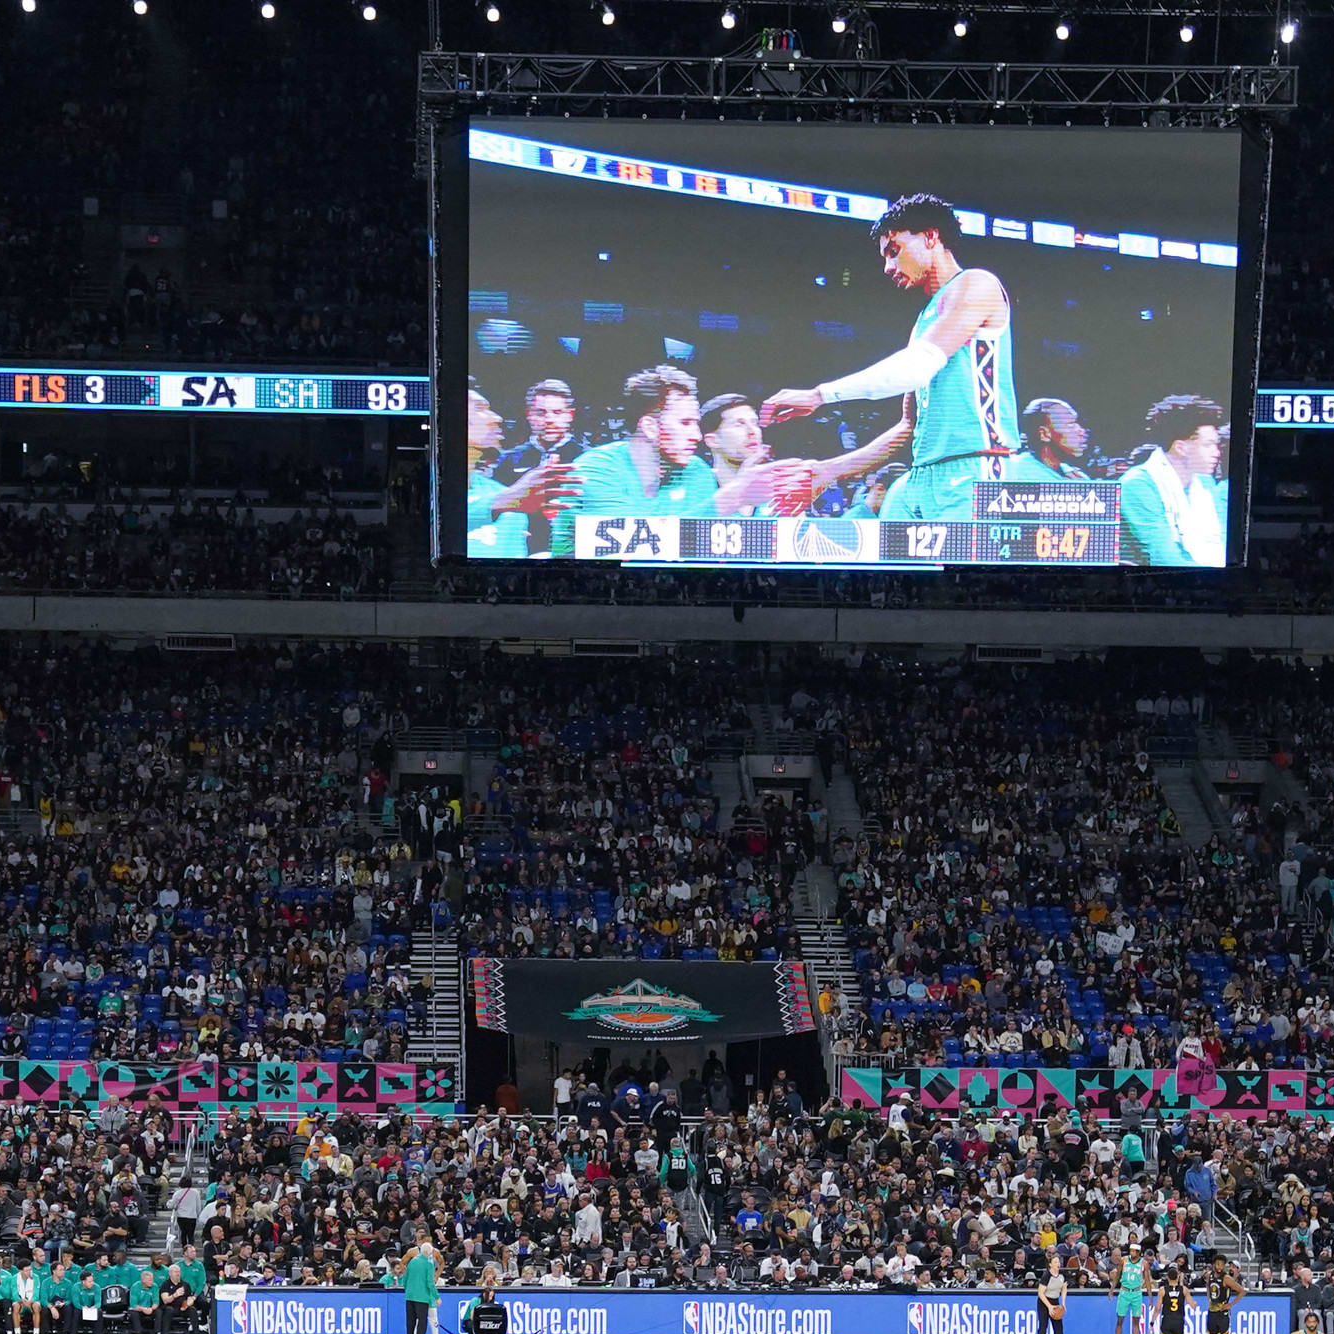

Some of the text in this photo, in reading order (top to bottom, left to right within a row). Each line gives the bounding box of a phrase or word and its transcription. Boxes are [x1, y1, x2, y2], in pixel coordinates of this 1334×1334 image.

[14, 373, 105, 404] FLS 3
[181, 375, 238, 408] SA
[274, 378, 408, 412] SA 93
[594, 517, 661, 557] SA
[710, 522, 743, 555] 93
[906, 525, 948, 558] 127
[989, 526, 1091, 559] QTR 6:47
[998, 544, 1012, 559] 4
[670, 1158, 687, 1170] 20
[1170, 1298, 1179, 1311] 3
